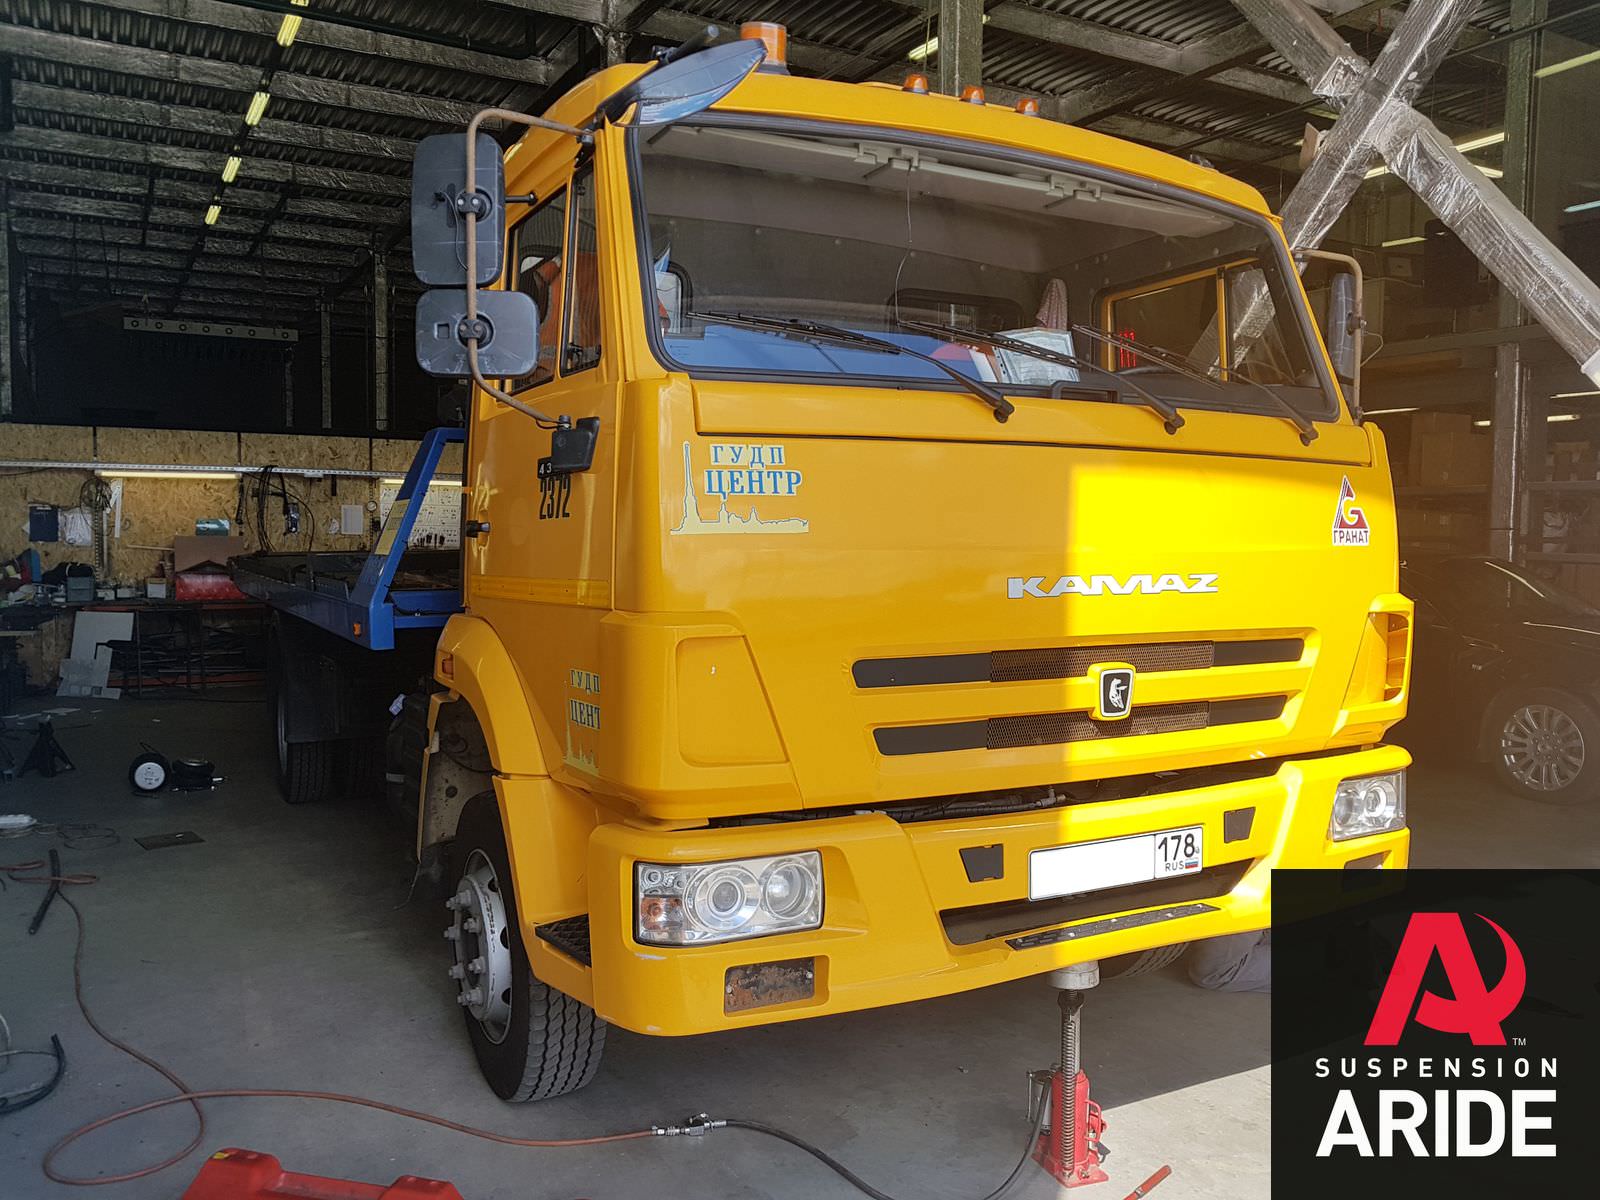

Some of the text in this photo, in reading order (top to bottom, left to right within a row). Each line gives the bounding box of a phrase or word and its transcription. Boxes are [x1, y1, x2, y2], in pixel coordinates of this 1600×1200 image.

[711, 445, 784, 468] ГУДП
[705, 469, 803, 500] ЦЕНТР
[539, 475, 571, 520] 2372
[1333, 530, 1369, 544] ГРАНАТ
[1007, 574, 1219, 599] KAMAZ
[1158, 833, 1195, 862] 178
[1165, 860, 1184, 871] RUS
